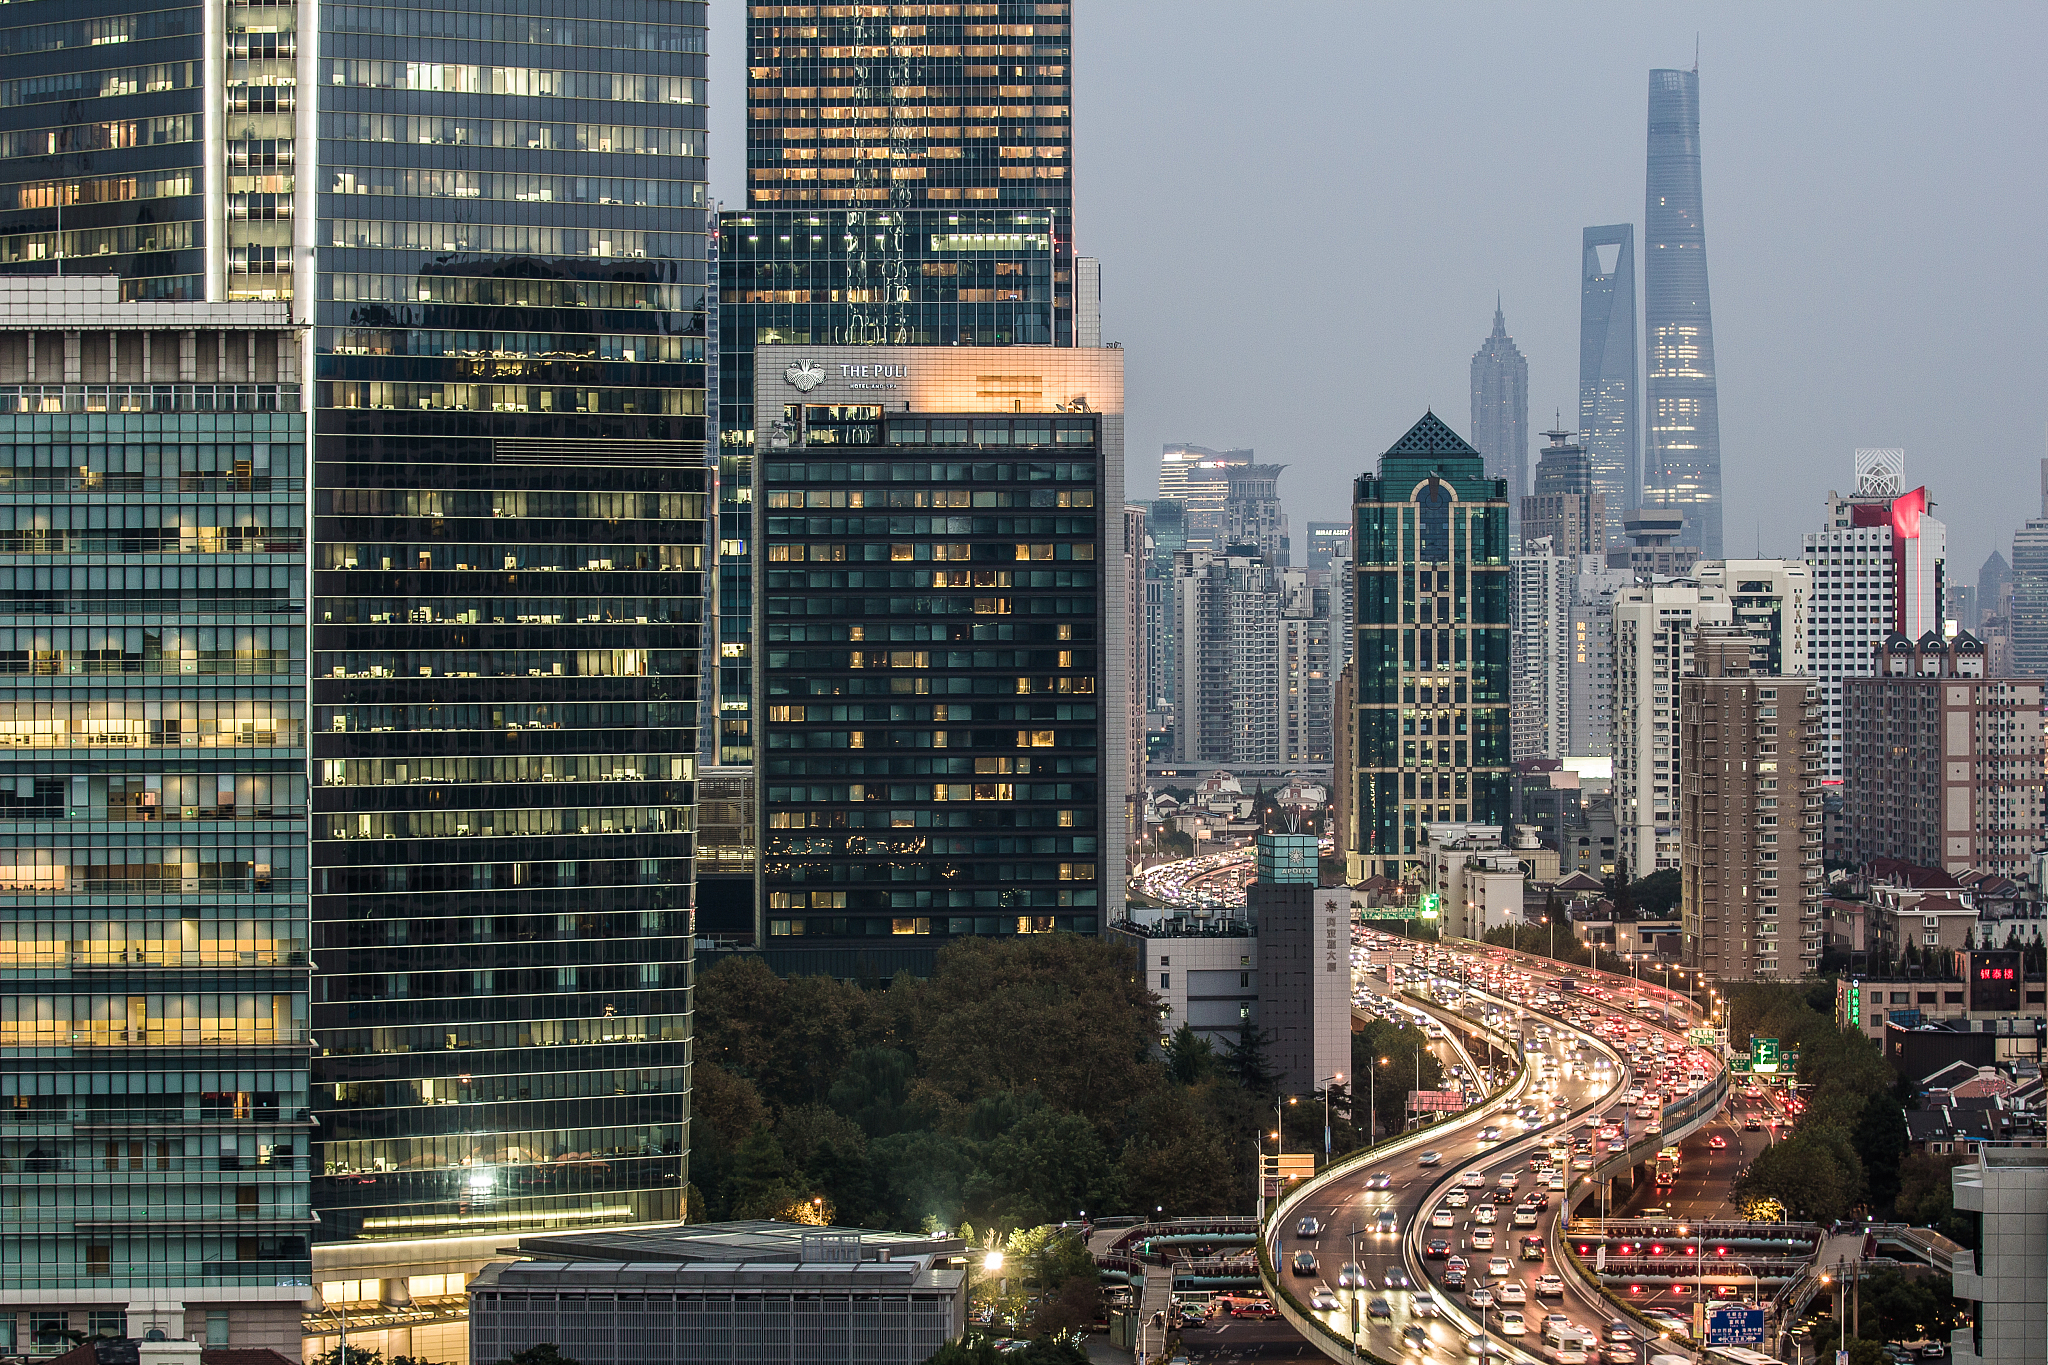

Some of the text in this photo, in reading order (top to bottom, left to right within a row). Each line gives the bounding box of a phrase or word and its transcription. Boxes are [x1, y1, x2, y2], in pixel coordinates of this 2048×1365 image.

[840, 364, 908, 378] THE PULI
[1576, 621, 1586, 663] 陕西大厦
[1281, 867, 1312, 875] APOLLO
